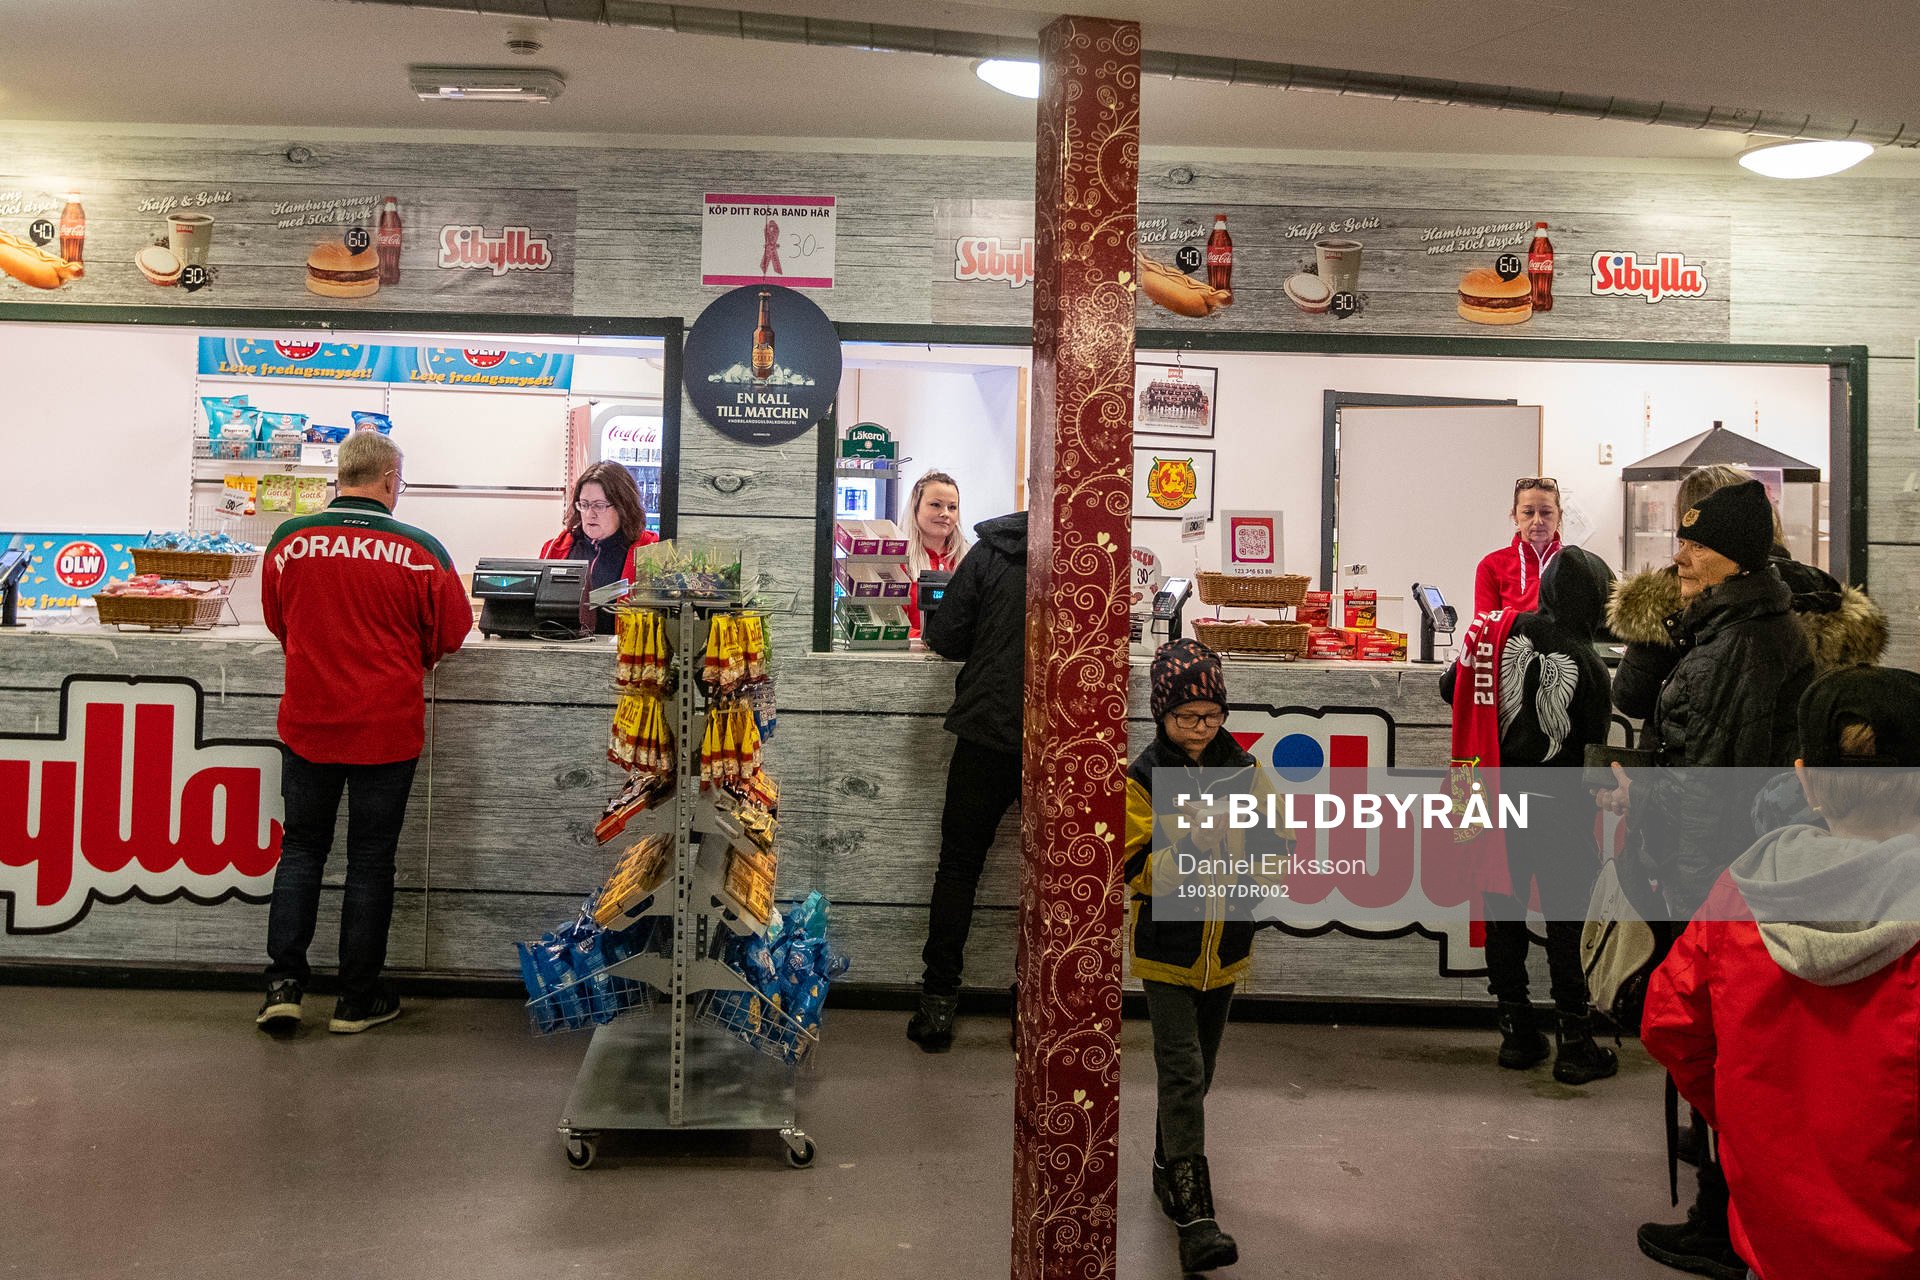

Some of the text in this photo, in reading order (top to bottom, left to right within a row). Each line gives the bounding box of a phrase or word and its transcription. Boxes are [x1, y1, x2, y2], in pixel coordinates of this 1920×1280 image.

[137, 191, 232, 215] Kaffe & Gobit
[271, 194, 381, 216] Hamburgermeny
[709, 205, 831, 218] KÖP DITT ROSA BAND HÄR
[278, 207, 373, 230] med 50cl dryck
[33, 223, 53, 240] 40
[1140, 224, 1206, 244] 50cl dryck
[1284, 217, 1381, 241] Kaffe & Gobit
[1420, 219, 1532, 241] Hamburgermeny
[348, 231, 367, 247] 60
[1427, 232, 1524, 255] med 50cl dryck
[441, 228, 549, 272] Sibylla
[1180, 250, 1200, 266] 40
[1499, 256, 1519, 273] 60
[185, 267, 204, 284] 30
[1595, 254, 1704, 299] Sibylla
[1335, 294, 1354, 310] 30
[218, 361, 374, 380] Leve fredagsmyset!
[410, 370, 554, 387] Leve fredagsmyset!
[737, 393, 791, 405] EN KALL
[716, 406, 809, 419] TILL MATCHEN
[852, 430, 885, 442] Läkerol
[60, 556, 101, 574] OLW
